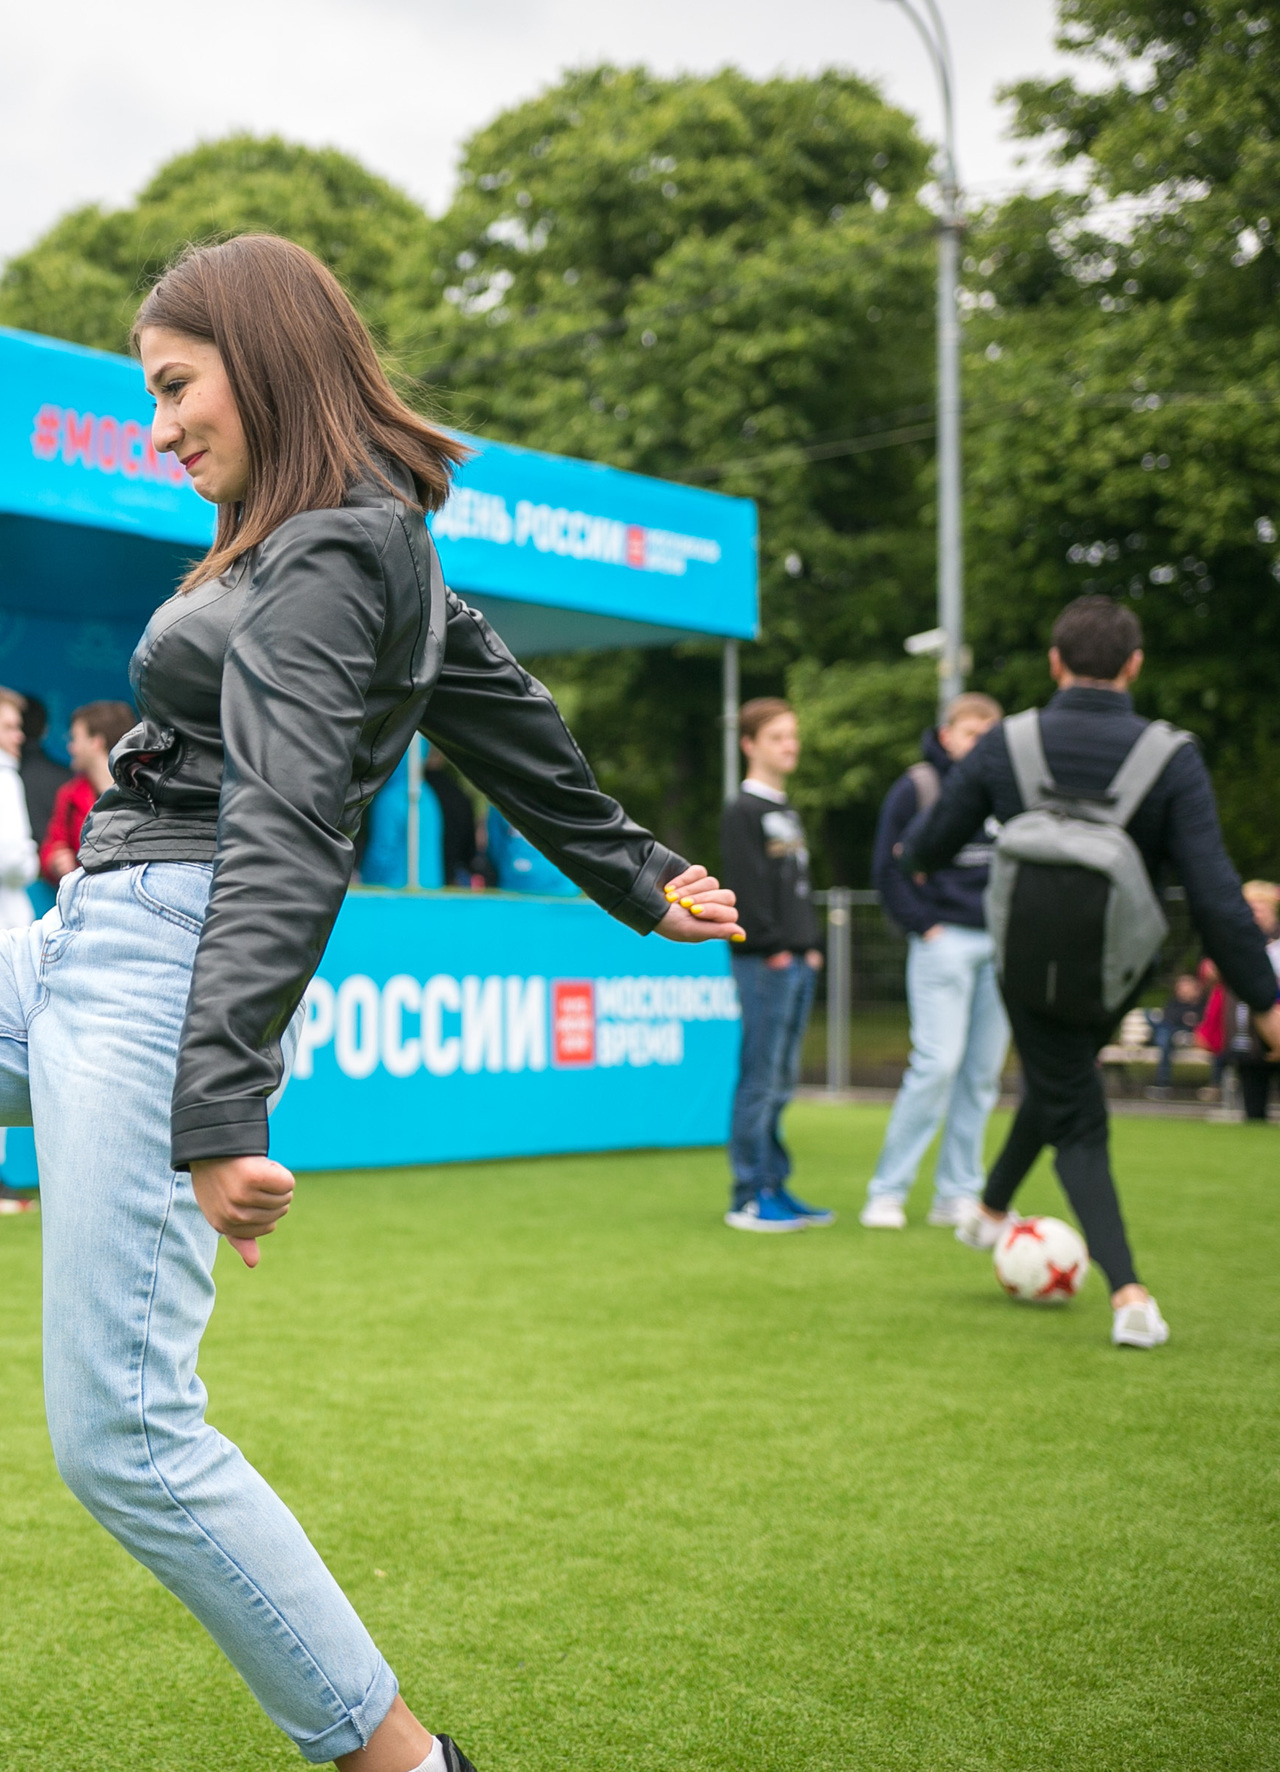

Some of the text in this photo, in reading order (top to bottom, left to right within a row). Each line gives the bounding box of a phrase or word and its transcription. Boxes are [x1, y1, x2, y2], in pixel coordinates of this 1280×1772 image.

[514, 499, 624, 566] РОССИИ
[291, 974, 547, 1080] РОССИИ
[596, 975, 741, 1022] МОСКОВСКО
